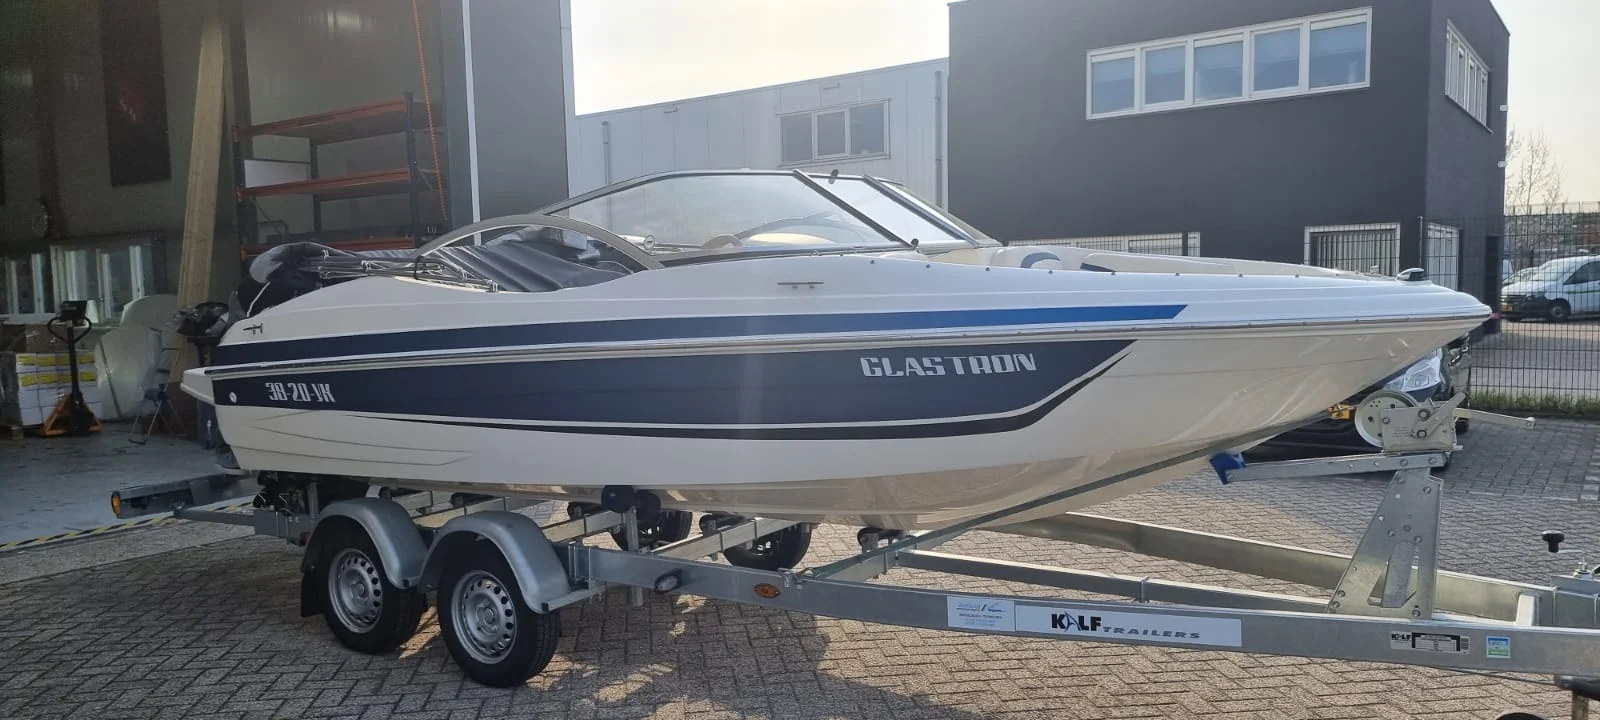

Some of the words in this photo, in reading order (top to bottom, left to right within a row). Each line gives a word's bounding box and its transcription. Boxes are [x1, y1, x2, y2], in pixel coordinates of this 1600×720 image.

[860, 353, 1037, 377] GLASTRON
[1051, 611, 1102, 632] KALF
[1103, 626, 1201, 639] TRAILERS
